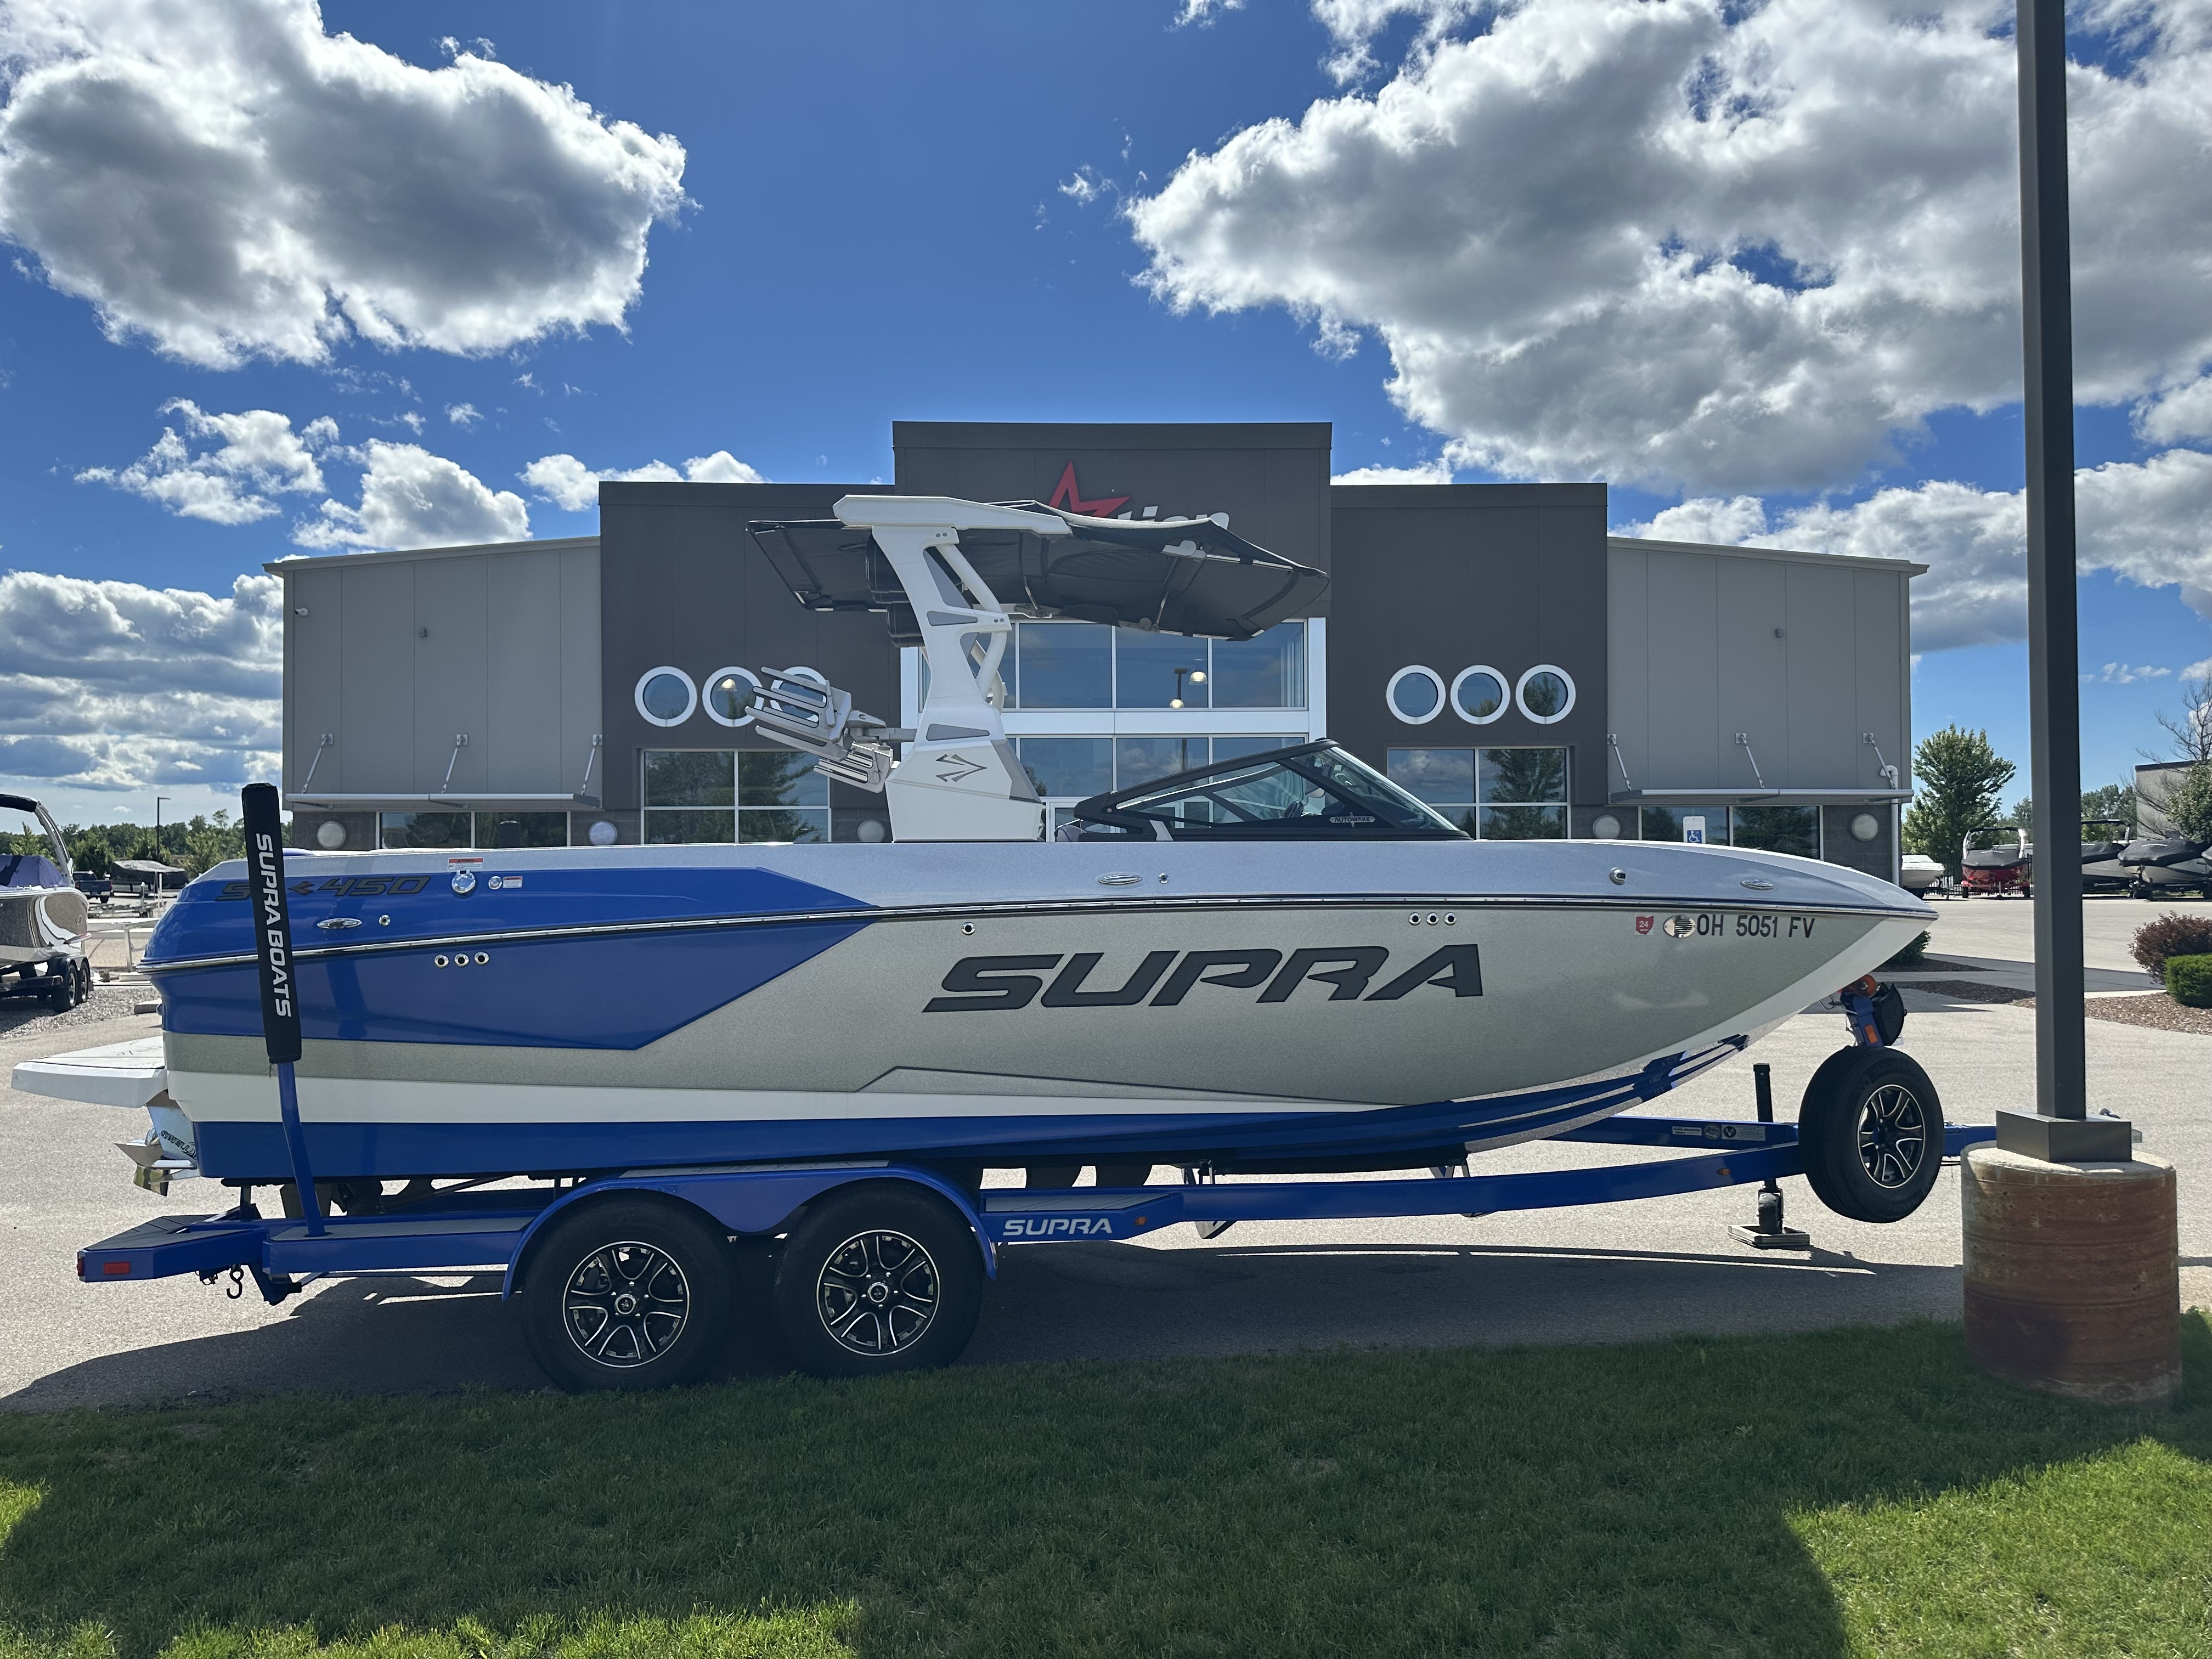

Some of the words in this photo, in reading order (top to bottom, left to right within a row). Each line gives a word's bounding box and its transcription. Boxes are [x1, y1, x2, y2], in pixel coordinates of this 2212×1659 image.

[256, 833, 281, 926] SUPRA
[317, 876, 431, 896] 450
[1697, 913, 1724, 936] OH
[1736, 915, 1778, 938] 5051
[1788, 916, 1815, 938] FV
[267, 929, 291, 1017] BOATS
[922, 944, 1483, 1013] SUPRA
[1002, 1218, 1113, 1236] SUPRA
